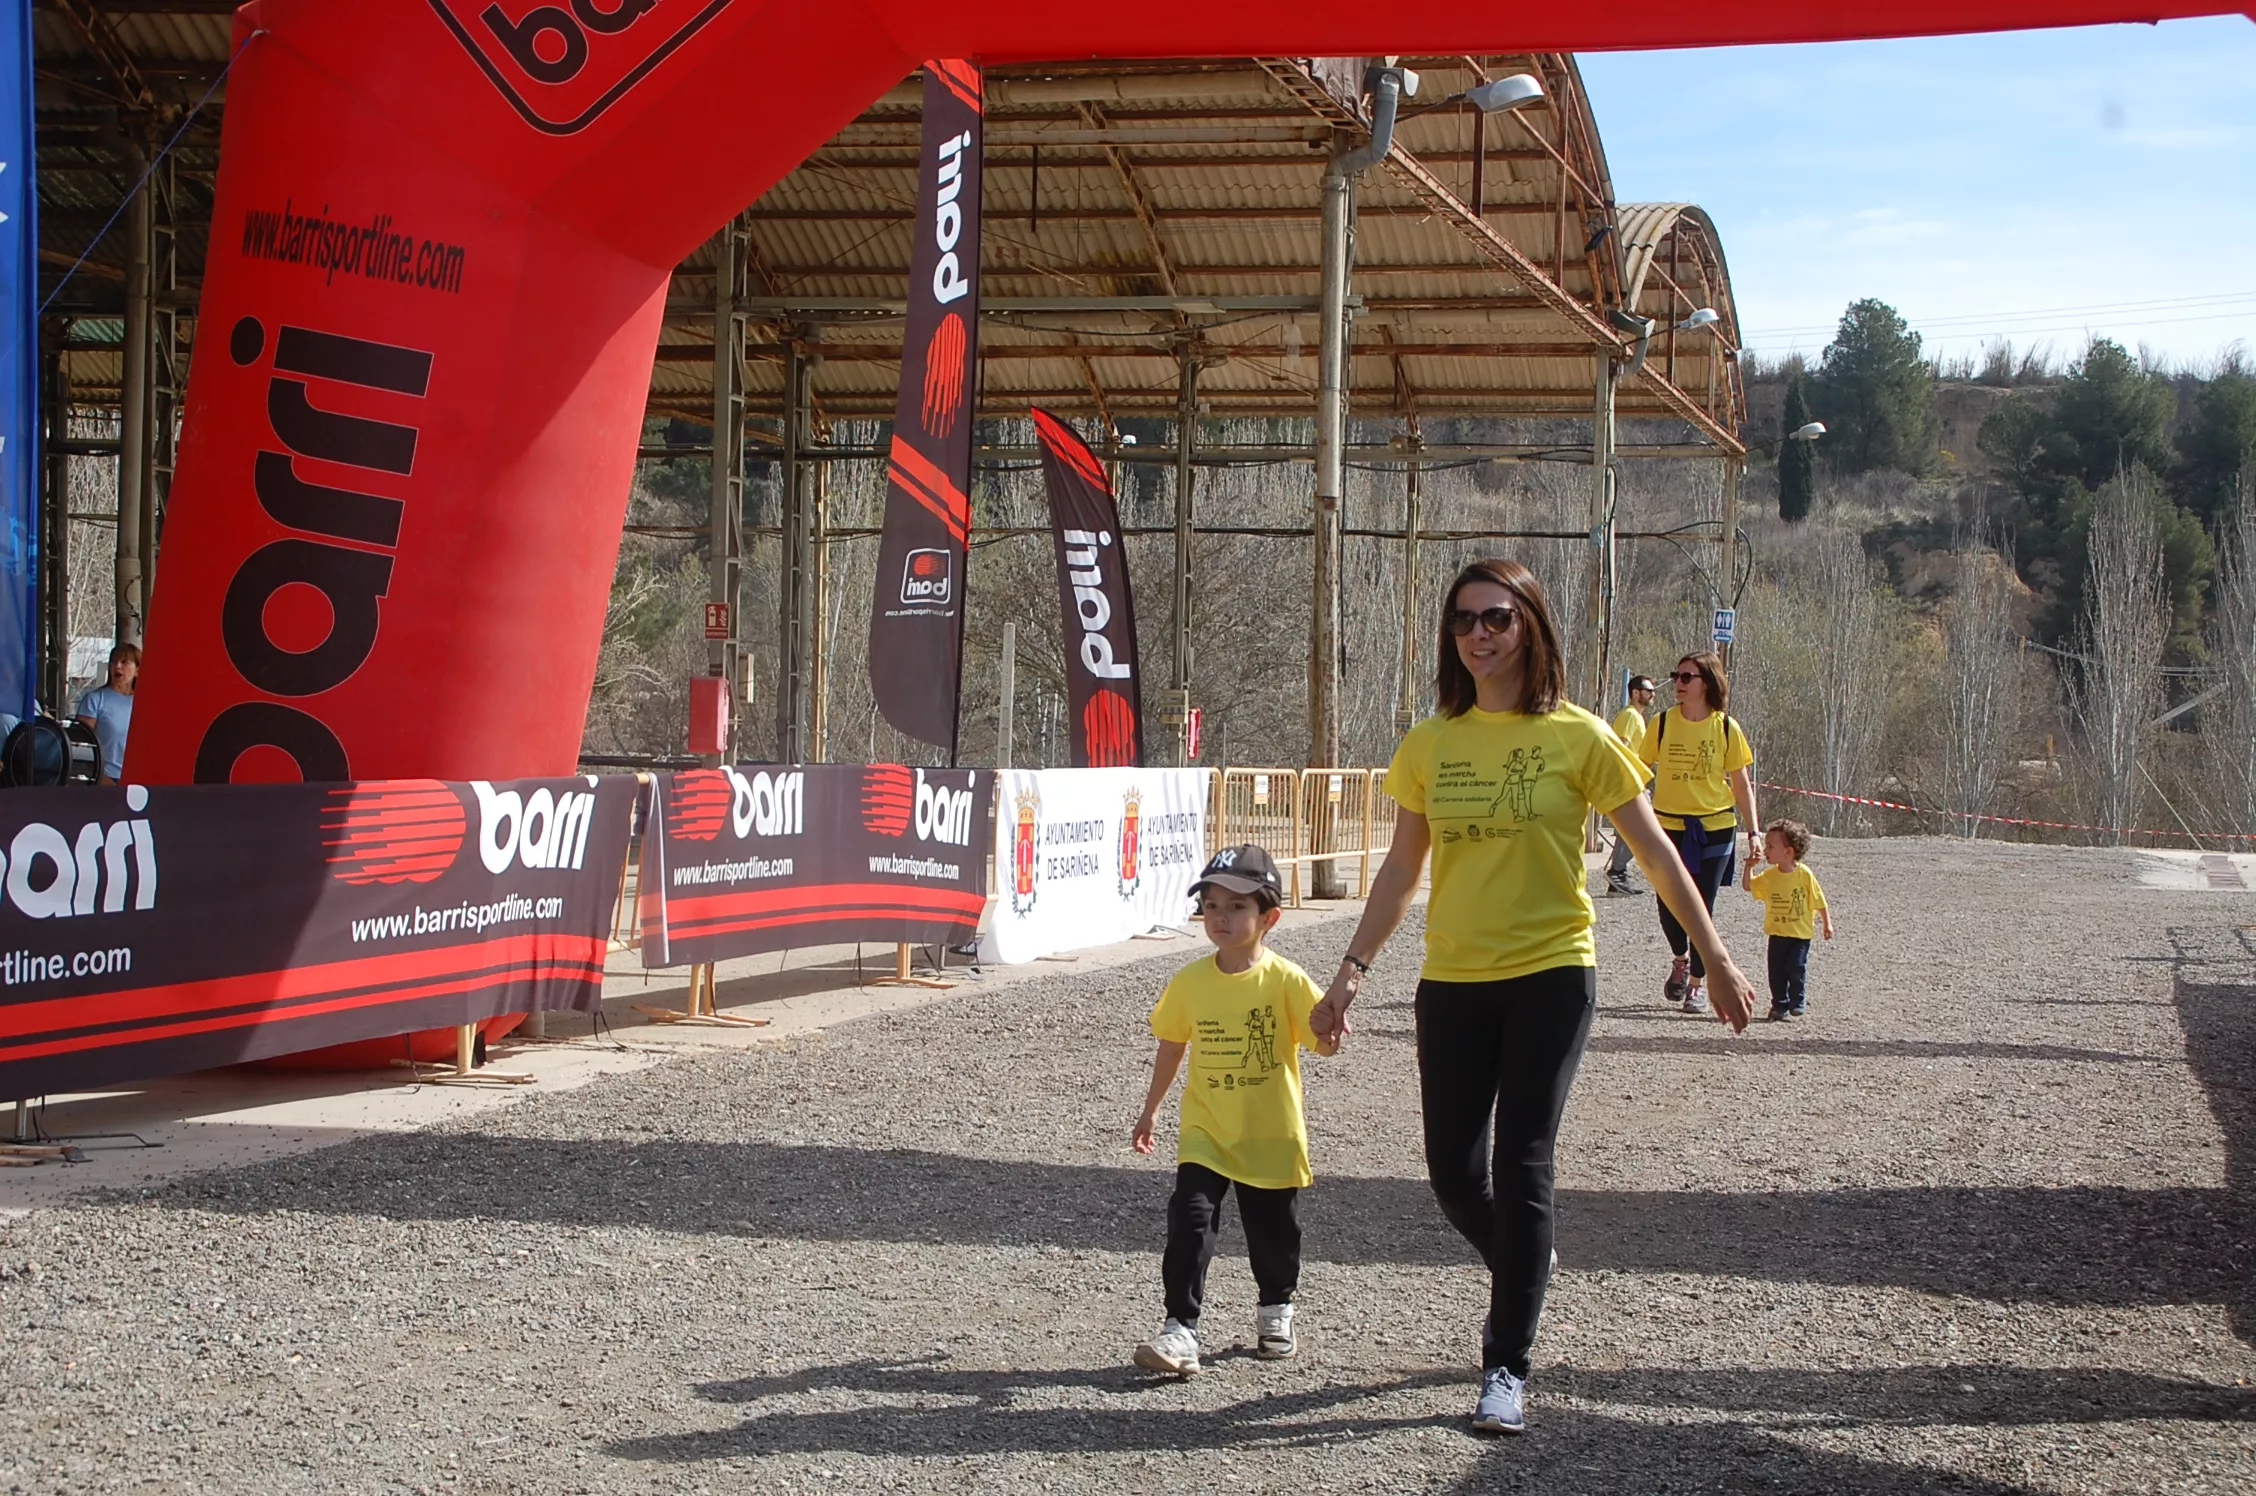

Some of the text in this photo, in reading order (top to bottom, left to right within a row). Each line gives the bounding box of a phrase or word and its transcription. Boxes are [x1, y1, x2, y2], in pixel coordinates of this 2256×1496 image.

[242, 197, 465, 293] www.barrisportline.com
[718, 764, 804, 839] barri
[915, 767, 976, 847] barri
[469, 774, 600, 875] barri
[1045, 819, 1105, 846] AYUNTAMIENTO
[1147, 812, 1198, 836] AYUNTAMIENTO
[0, 784, 158, 919] arri
[673, 855, 794, 886] www.barrisportline.com
[868, 852, 960, 881] www.barrisportline.com
[1047, 849, 1100, 880] DE SARIÑENA
[1149, 847, 1159, 867] DE
[351, 893, 563, 943] www.barrisportline.com
